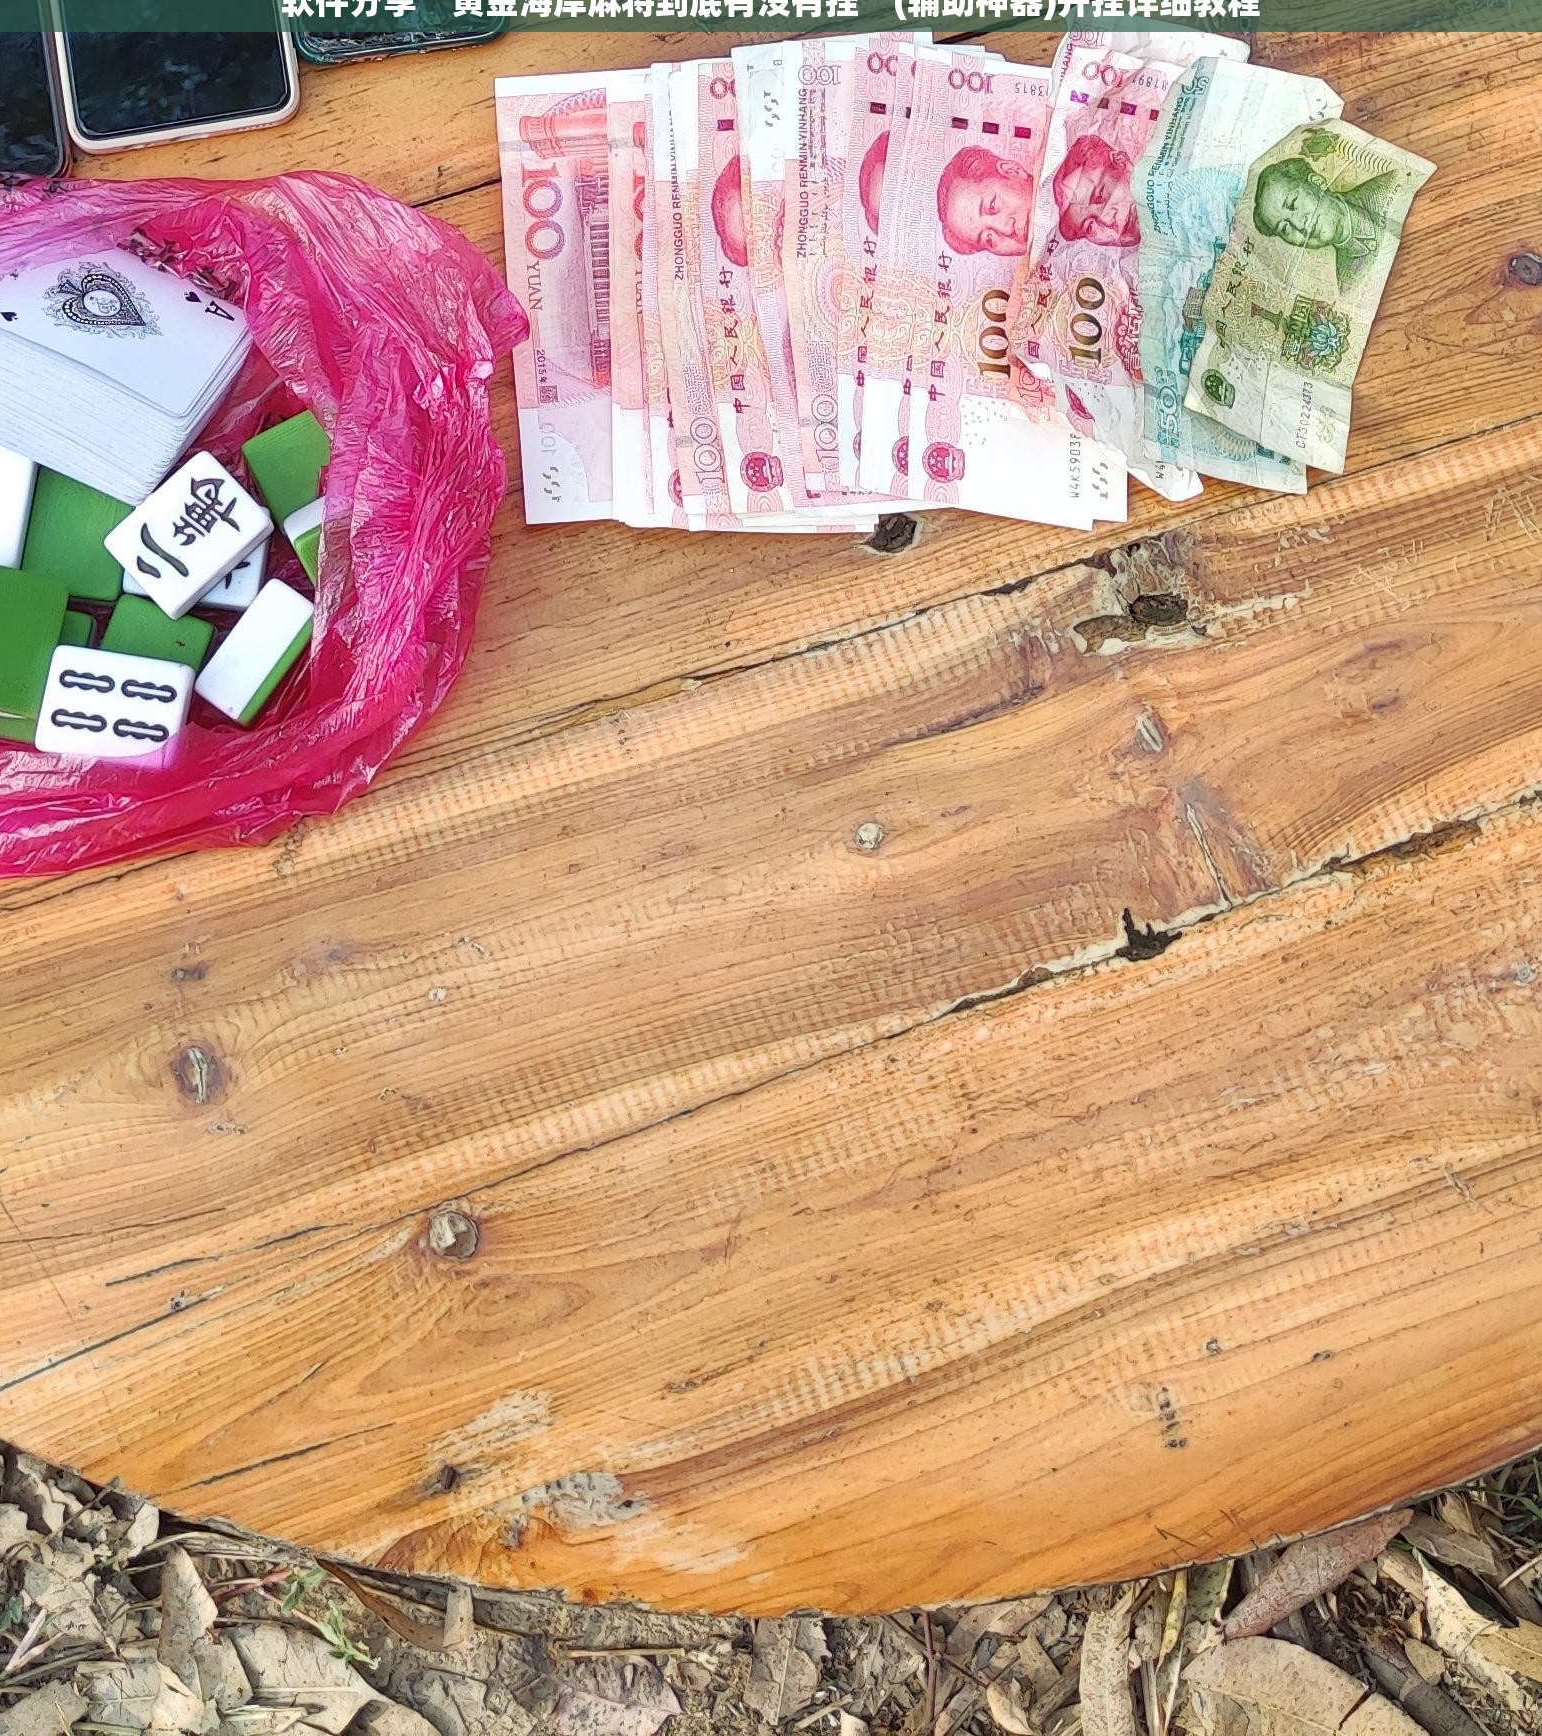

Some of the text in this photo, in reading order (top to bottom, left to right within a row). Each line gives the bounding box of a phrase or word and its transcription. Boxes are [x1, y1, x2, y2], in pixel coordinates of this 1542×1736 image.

[947, 68, 995, 94] 100
[521, 162, 566, 260] 100
[672, 212, 684, 281] ZHONGGUO
[796, 191, 809, 258] ZHONGGUO
[203, 299, 236, 322] A
[526, 261, 543, 311] YUAN
[927, 250, 953, 402] 中国人民银行
[1027, 238, 1060, 359] 国人民银行
[1068, 276, 1106, 368] 100
[720, 267, 751, 414] 中国人民银行
[977, 289, 1010, 379] 100
